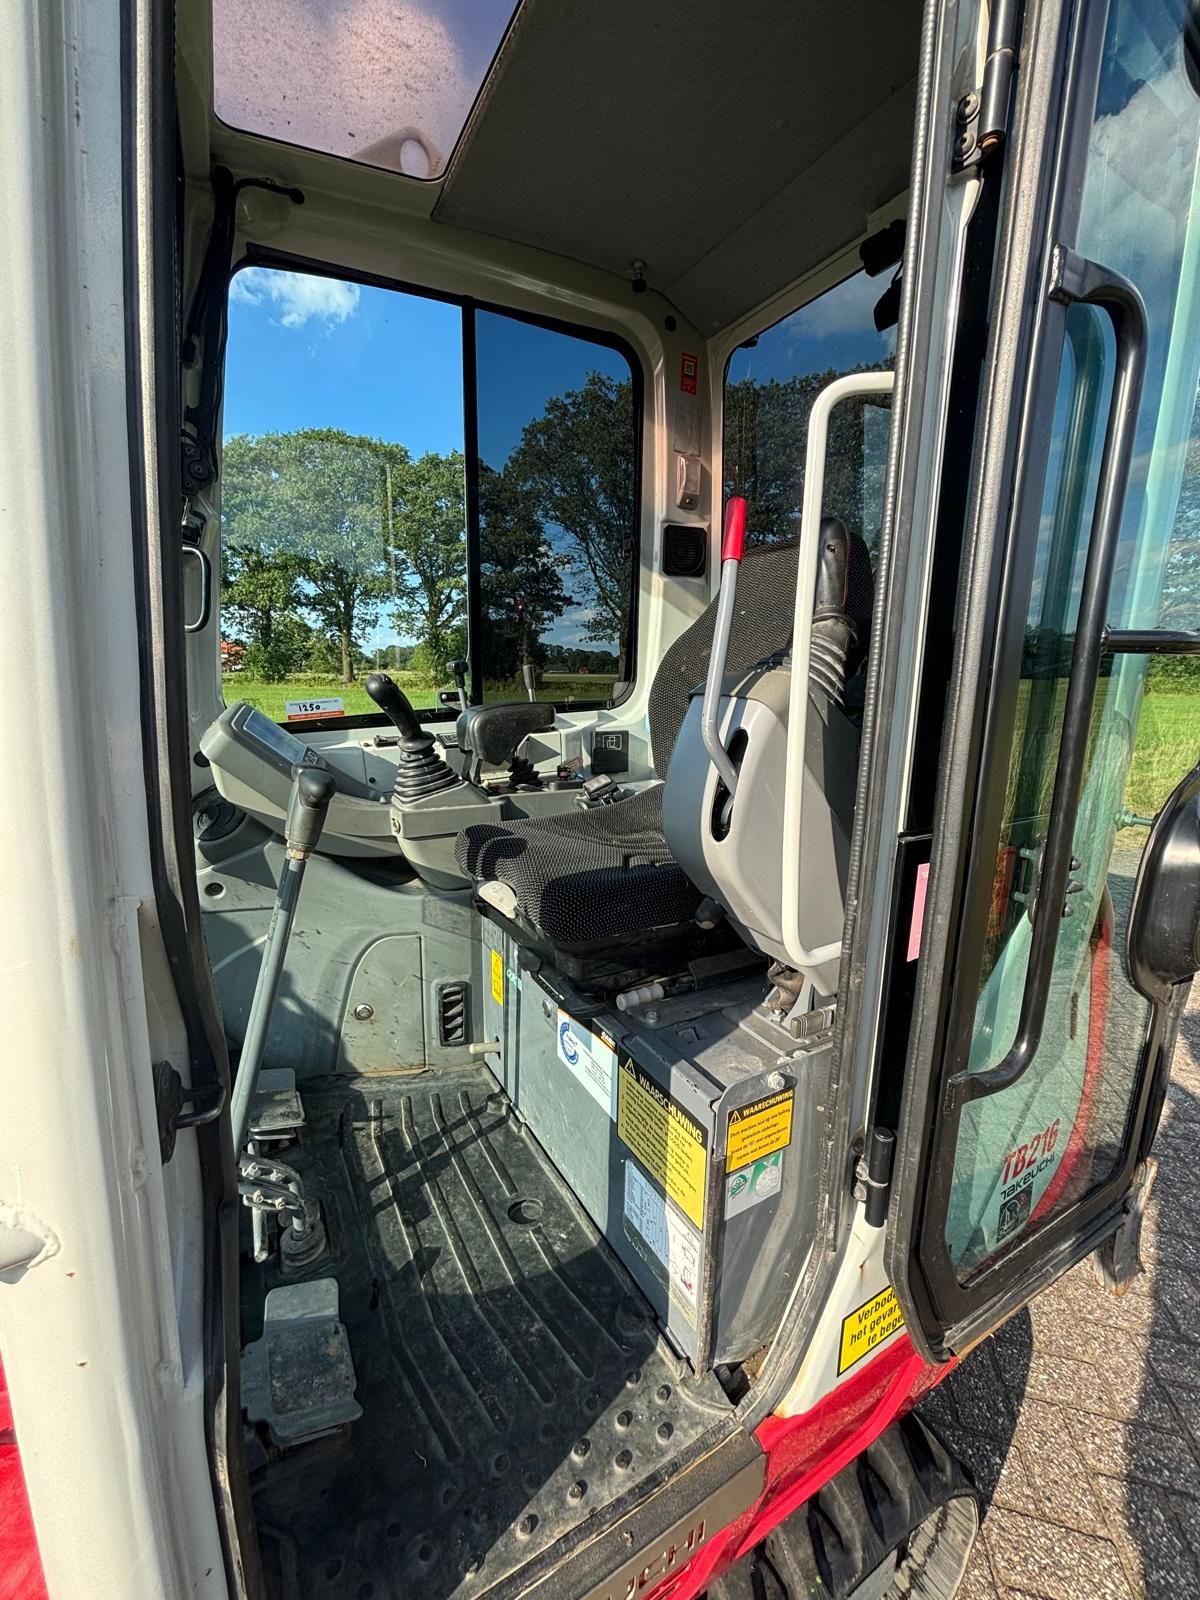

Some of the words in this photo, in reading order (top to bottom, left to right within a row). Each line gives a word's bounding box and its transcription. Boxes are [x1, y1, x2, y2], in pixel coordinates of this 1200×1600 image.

[299, 703, 321, 712] 1250
[639, 1073, 703, 1144] WAARSCHUWING
[743, 1089, 794, 1117] WAARSCHUWING
[1003, 1118, 1060, 1185] TB216
[850, 1324, 867, 1346] het
[869, 1303, 900, 1334] gevar
[867, 1333, 878, 1346] te
